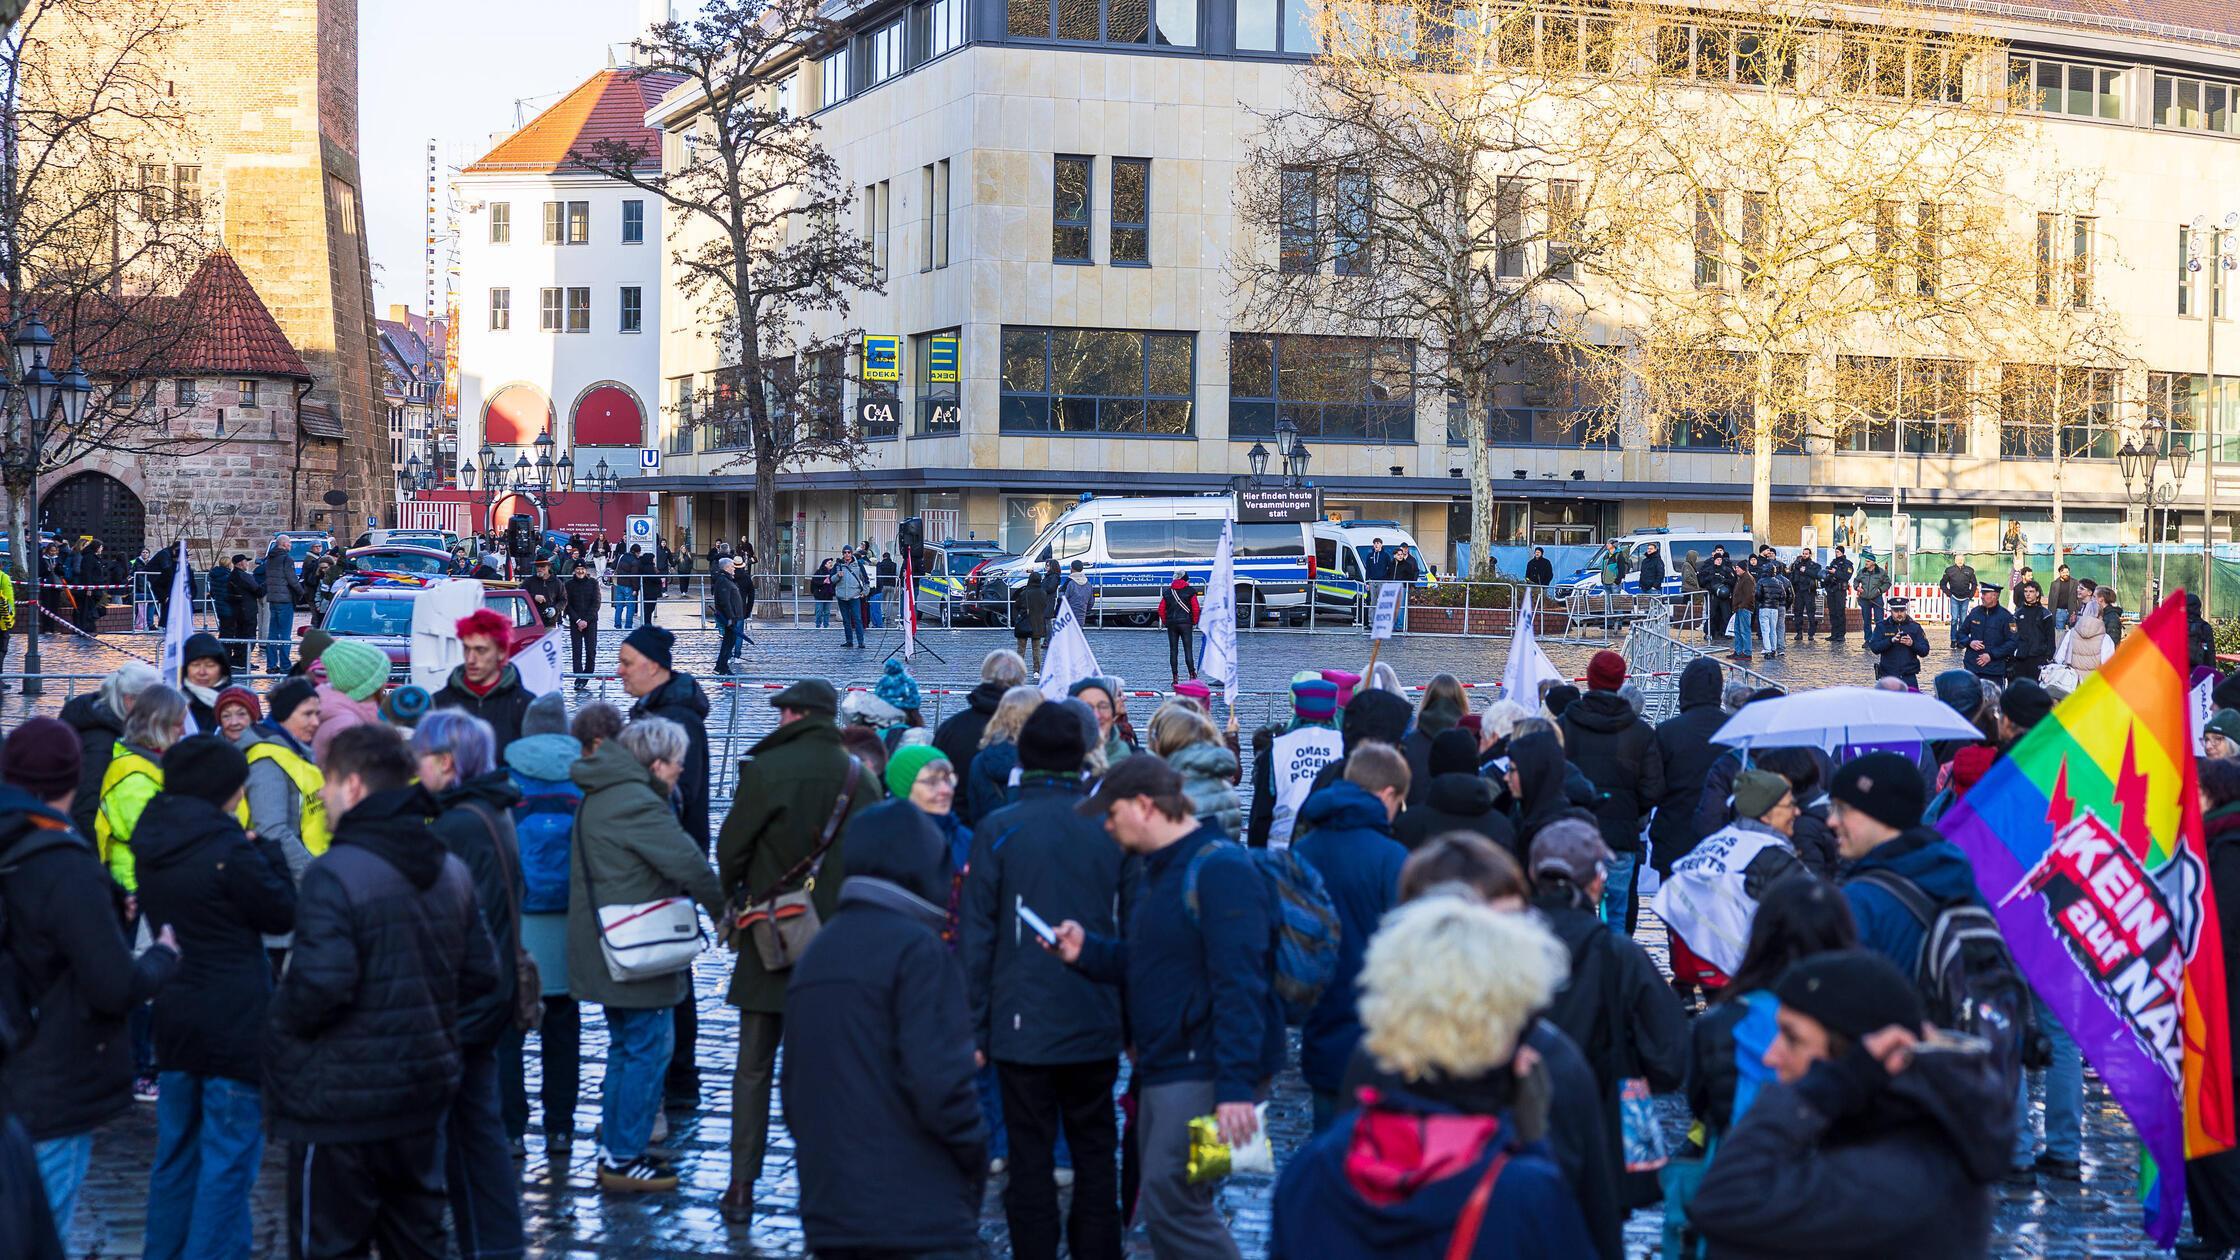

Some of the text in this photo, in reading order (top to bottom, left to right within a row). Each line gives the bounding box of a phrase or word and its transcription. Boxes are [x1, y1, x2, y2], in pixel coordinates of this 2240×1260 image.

[863, 403, 895, 422] C&A
[643, 451, 658, 468] U
[1243, 492, 1312, 500] Hier finden heute
[1012, 501, 1052, 518] New
[1245, 501, 1310, 510] Versammlungen
[1268, 510, 1288, 518] statt
[368, 517, 376, 526] U
[1121, 574, 1154, 582] POLIZEI
[2059, 823, 2170, 950] KEIN
[2066, 899, 2128, 967] auf
